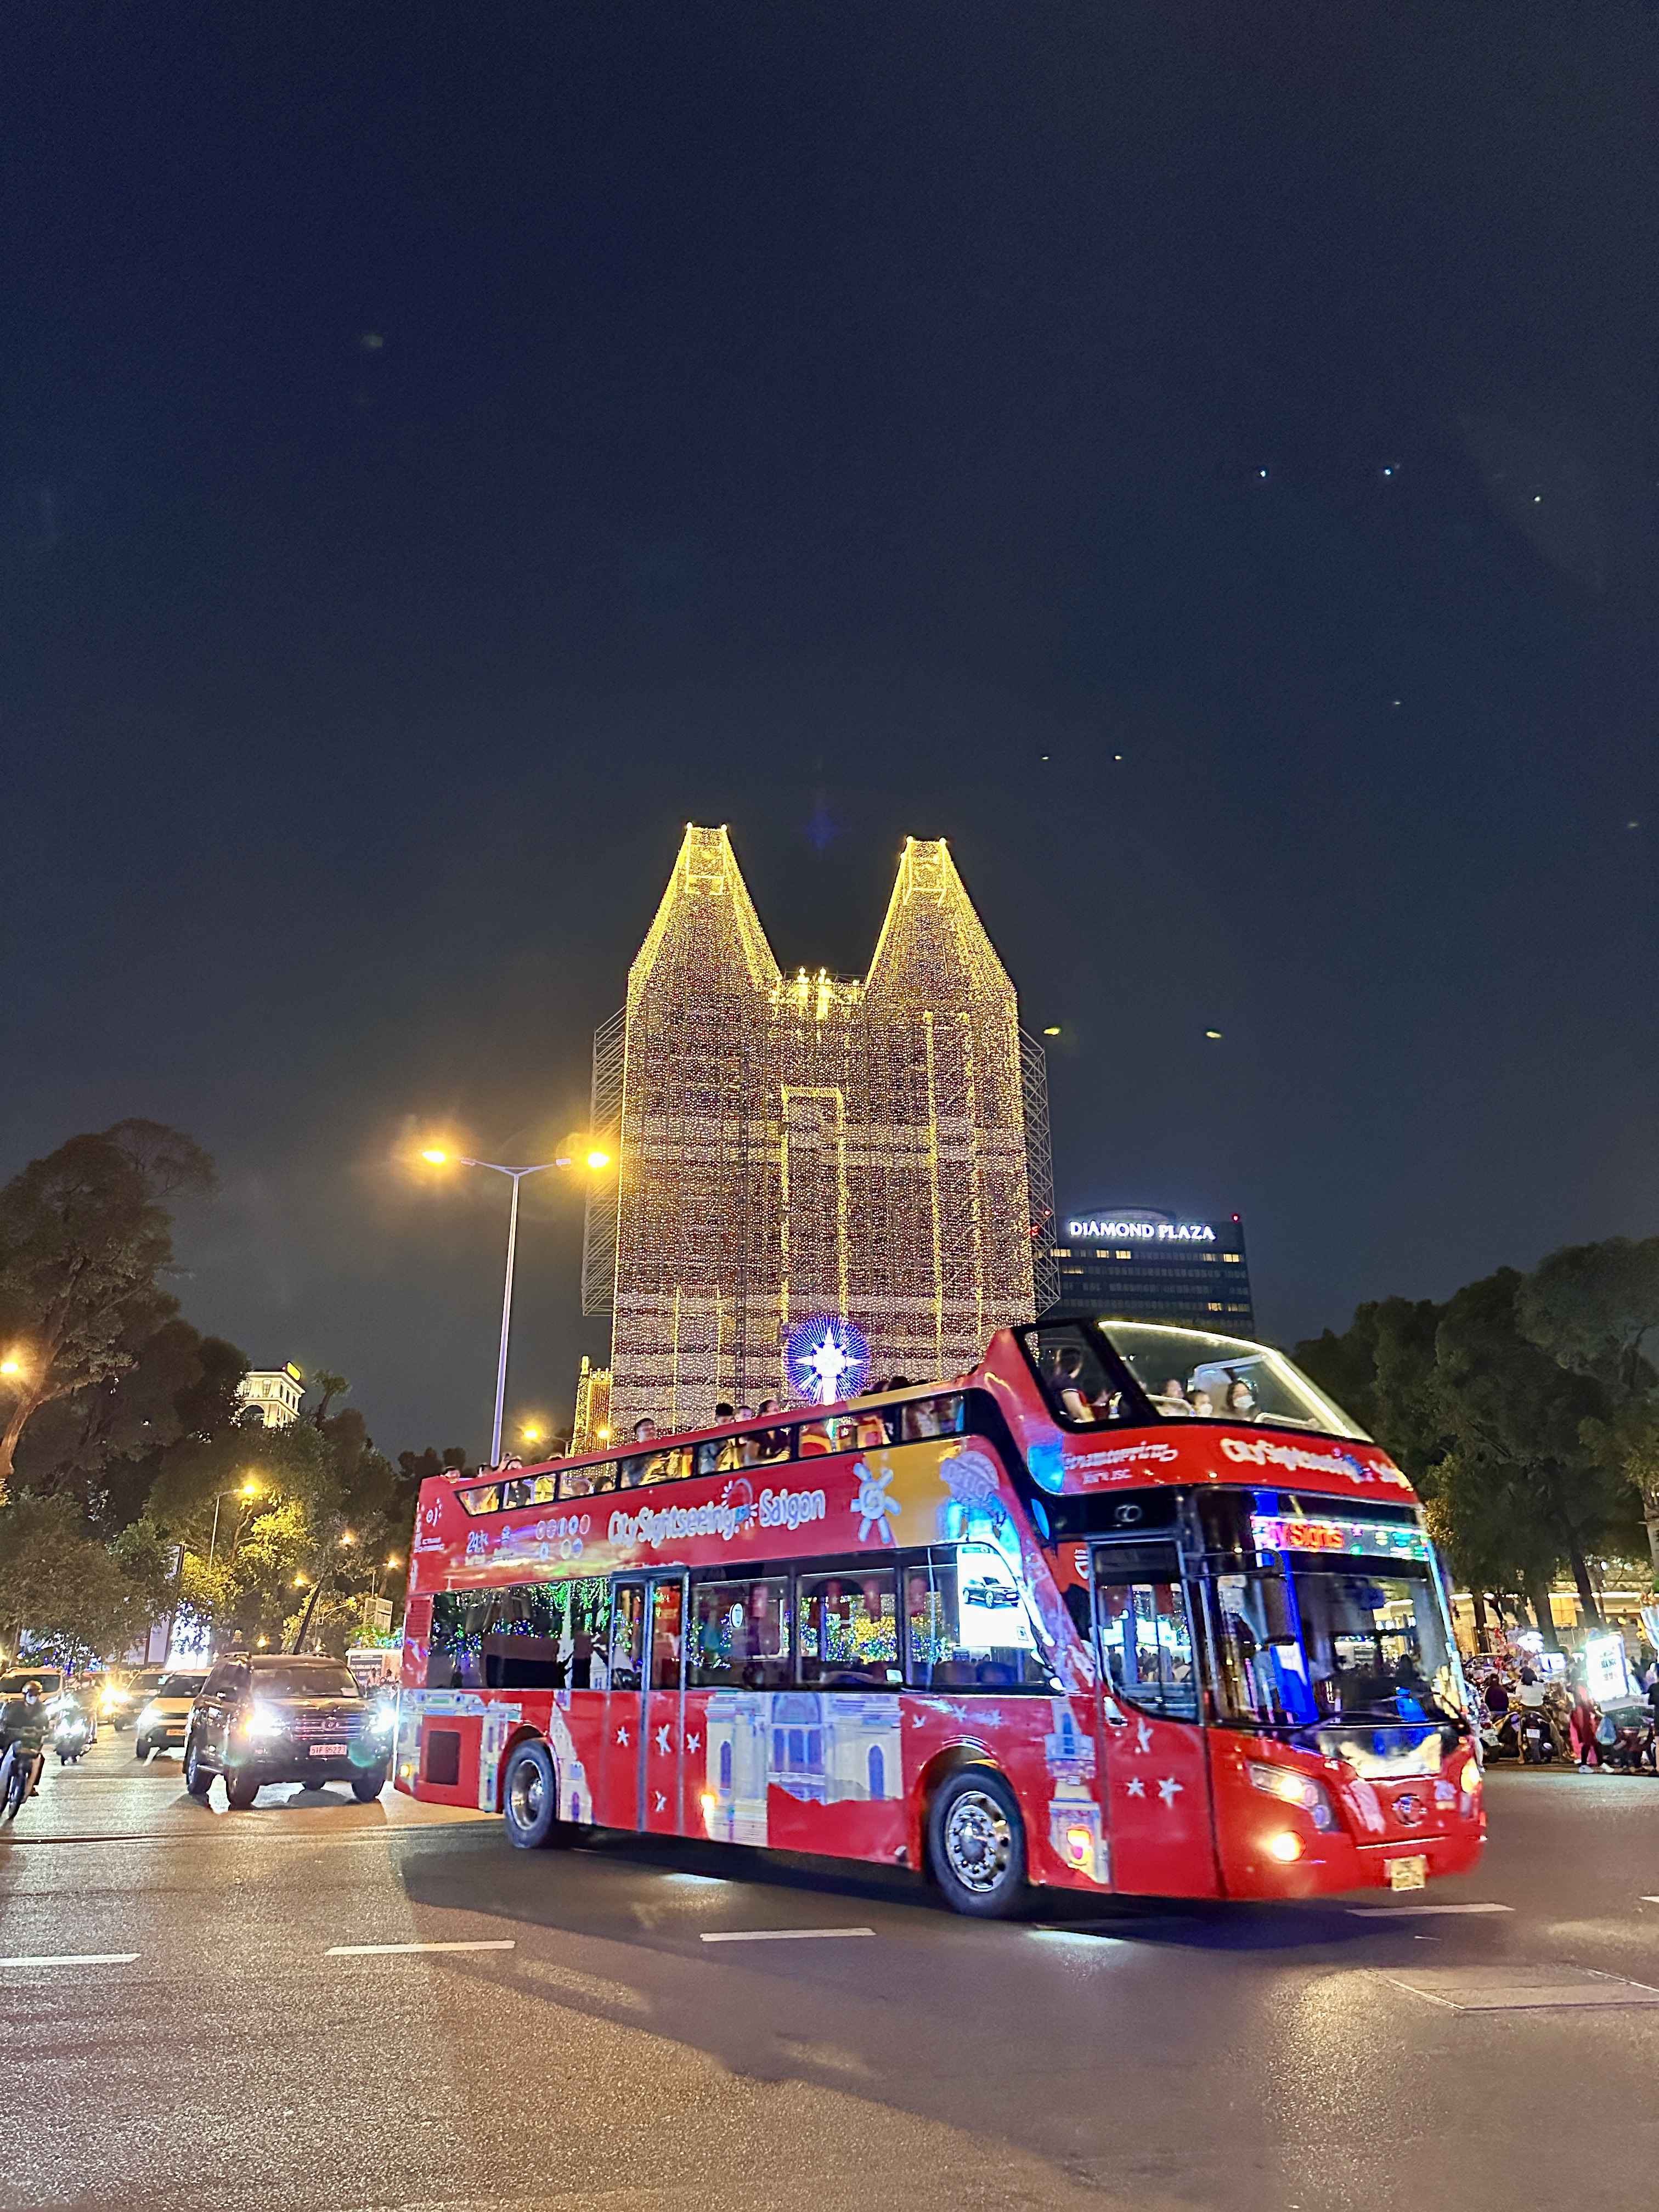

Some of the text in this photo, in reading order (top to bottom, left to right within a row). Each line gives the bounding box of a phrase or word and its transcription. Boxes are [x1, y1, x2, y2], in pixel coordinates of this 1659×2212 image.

[1070, 1221, 1216, 1241] DIAMOND PLAZA
[759, 1488, 826, 1531] Saigon
